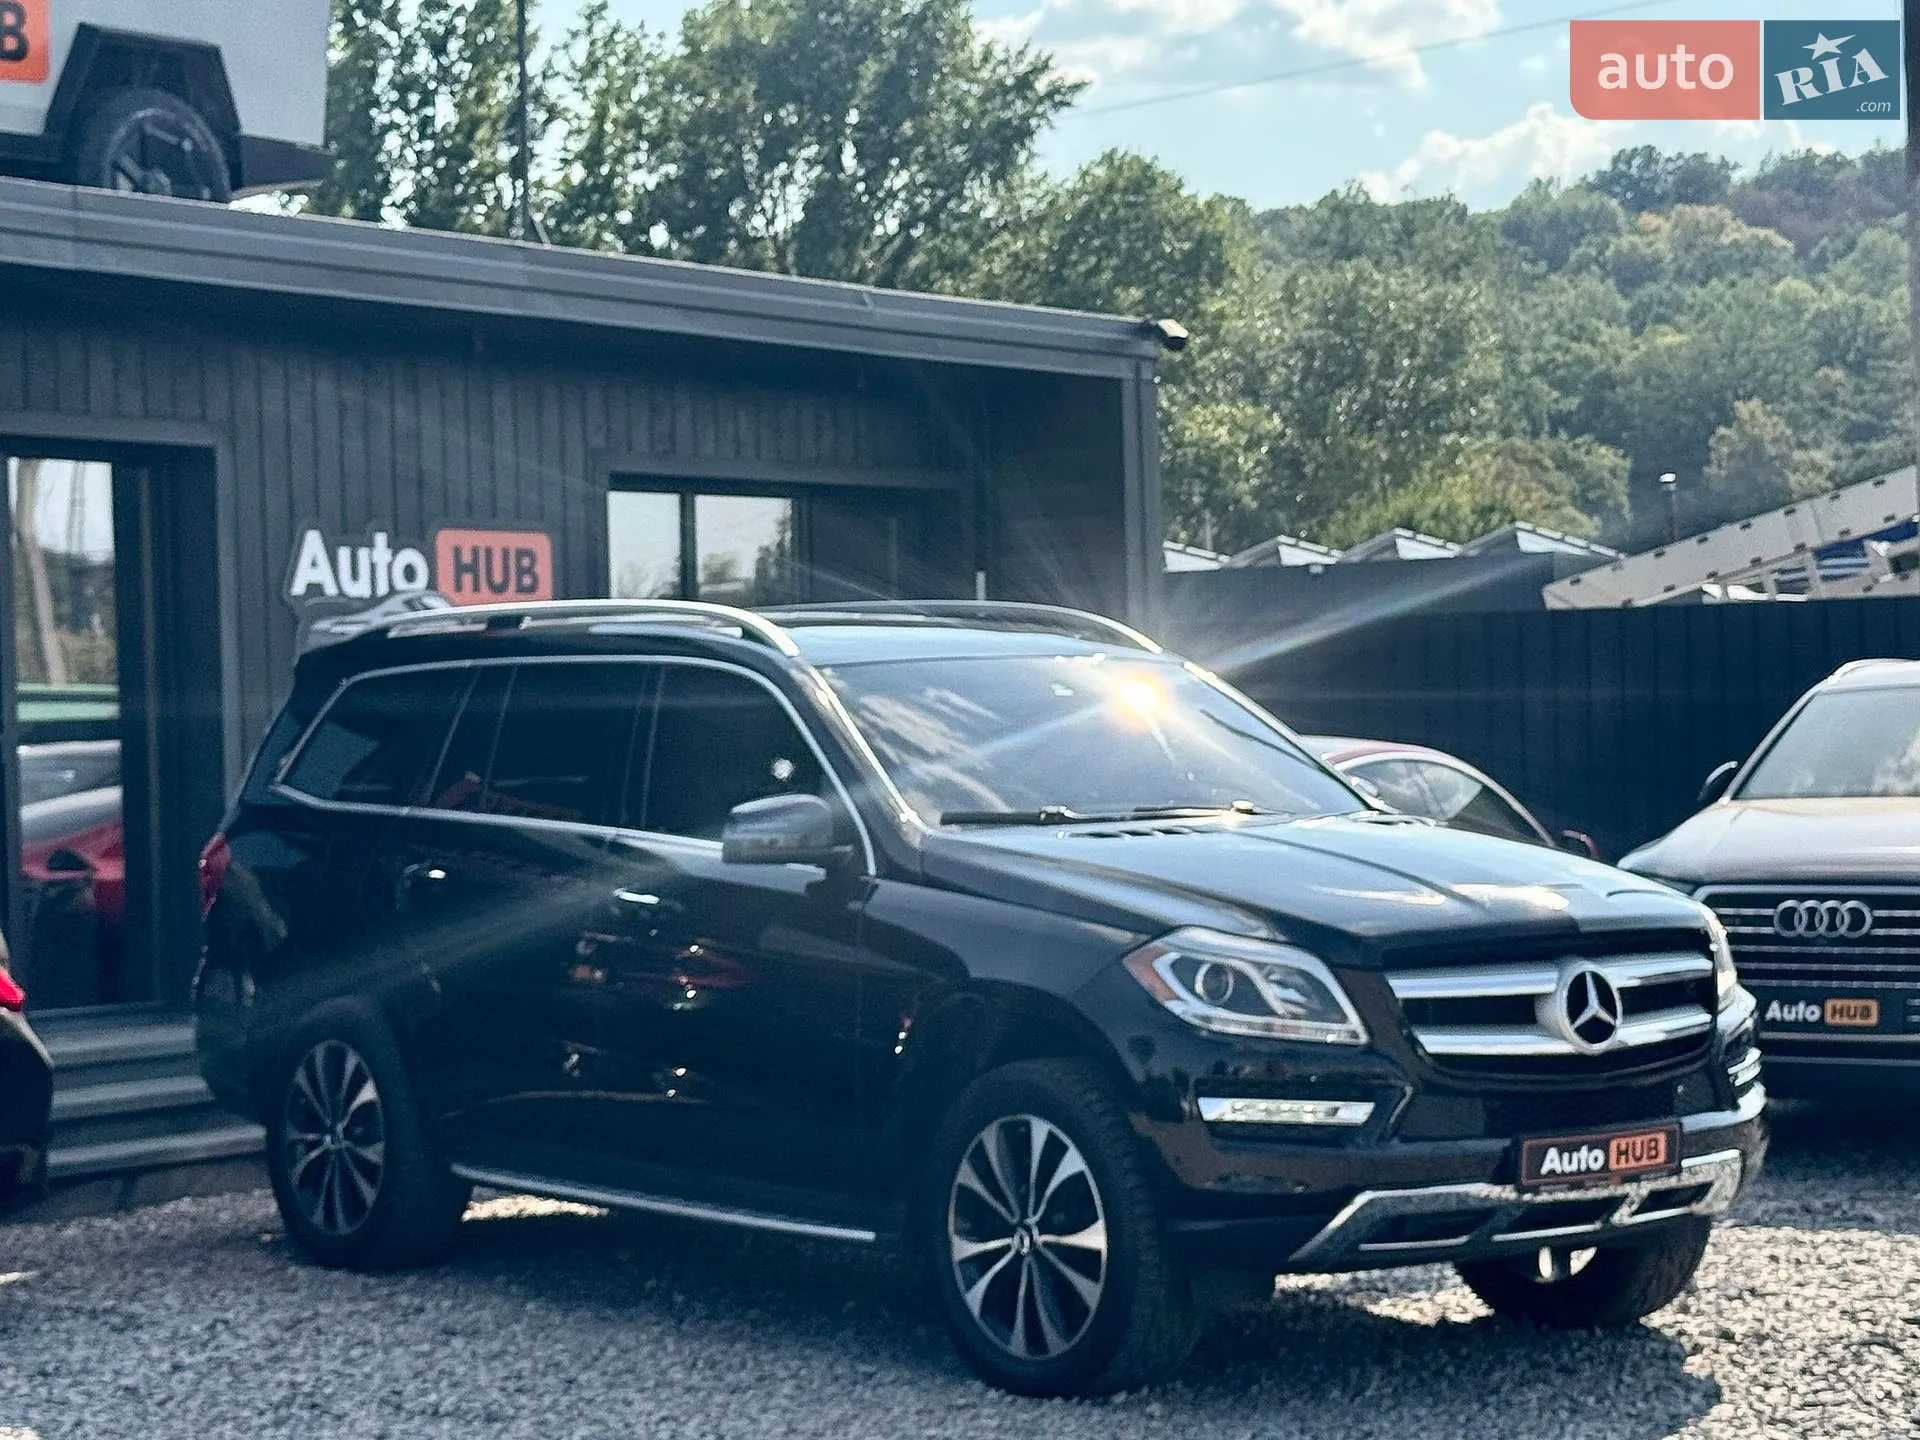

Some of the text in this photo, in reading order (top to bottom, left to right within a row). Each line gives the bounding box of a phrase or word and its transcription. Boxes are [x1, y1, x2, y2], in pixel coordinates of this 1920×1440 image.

[290, 529, 539, 599] Auto HUB
[1764, 1000, 1872, 1023] Auto HUB
[1540, 1137, 1660, 1176] Auto HUB
